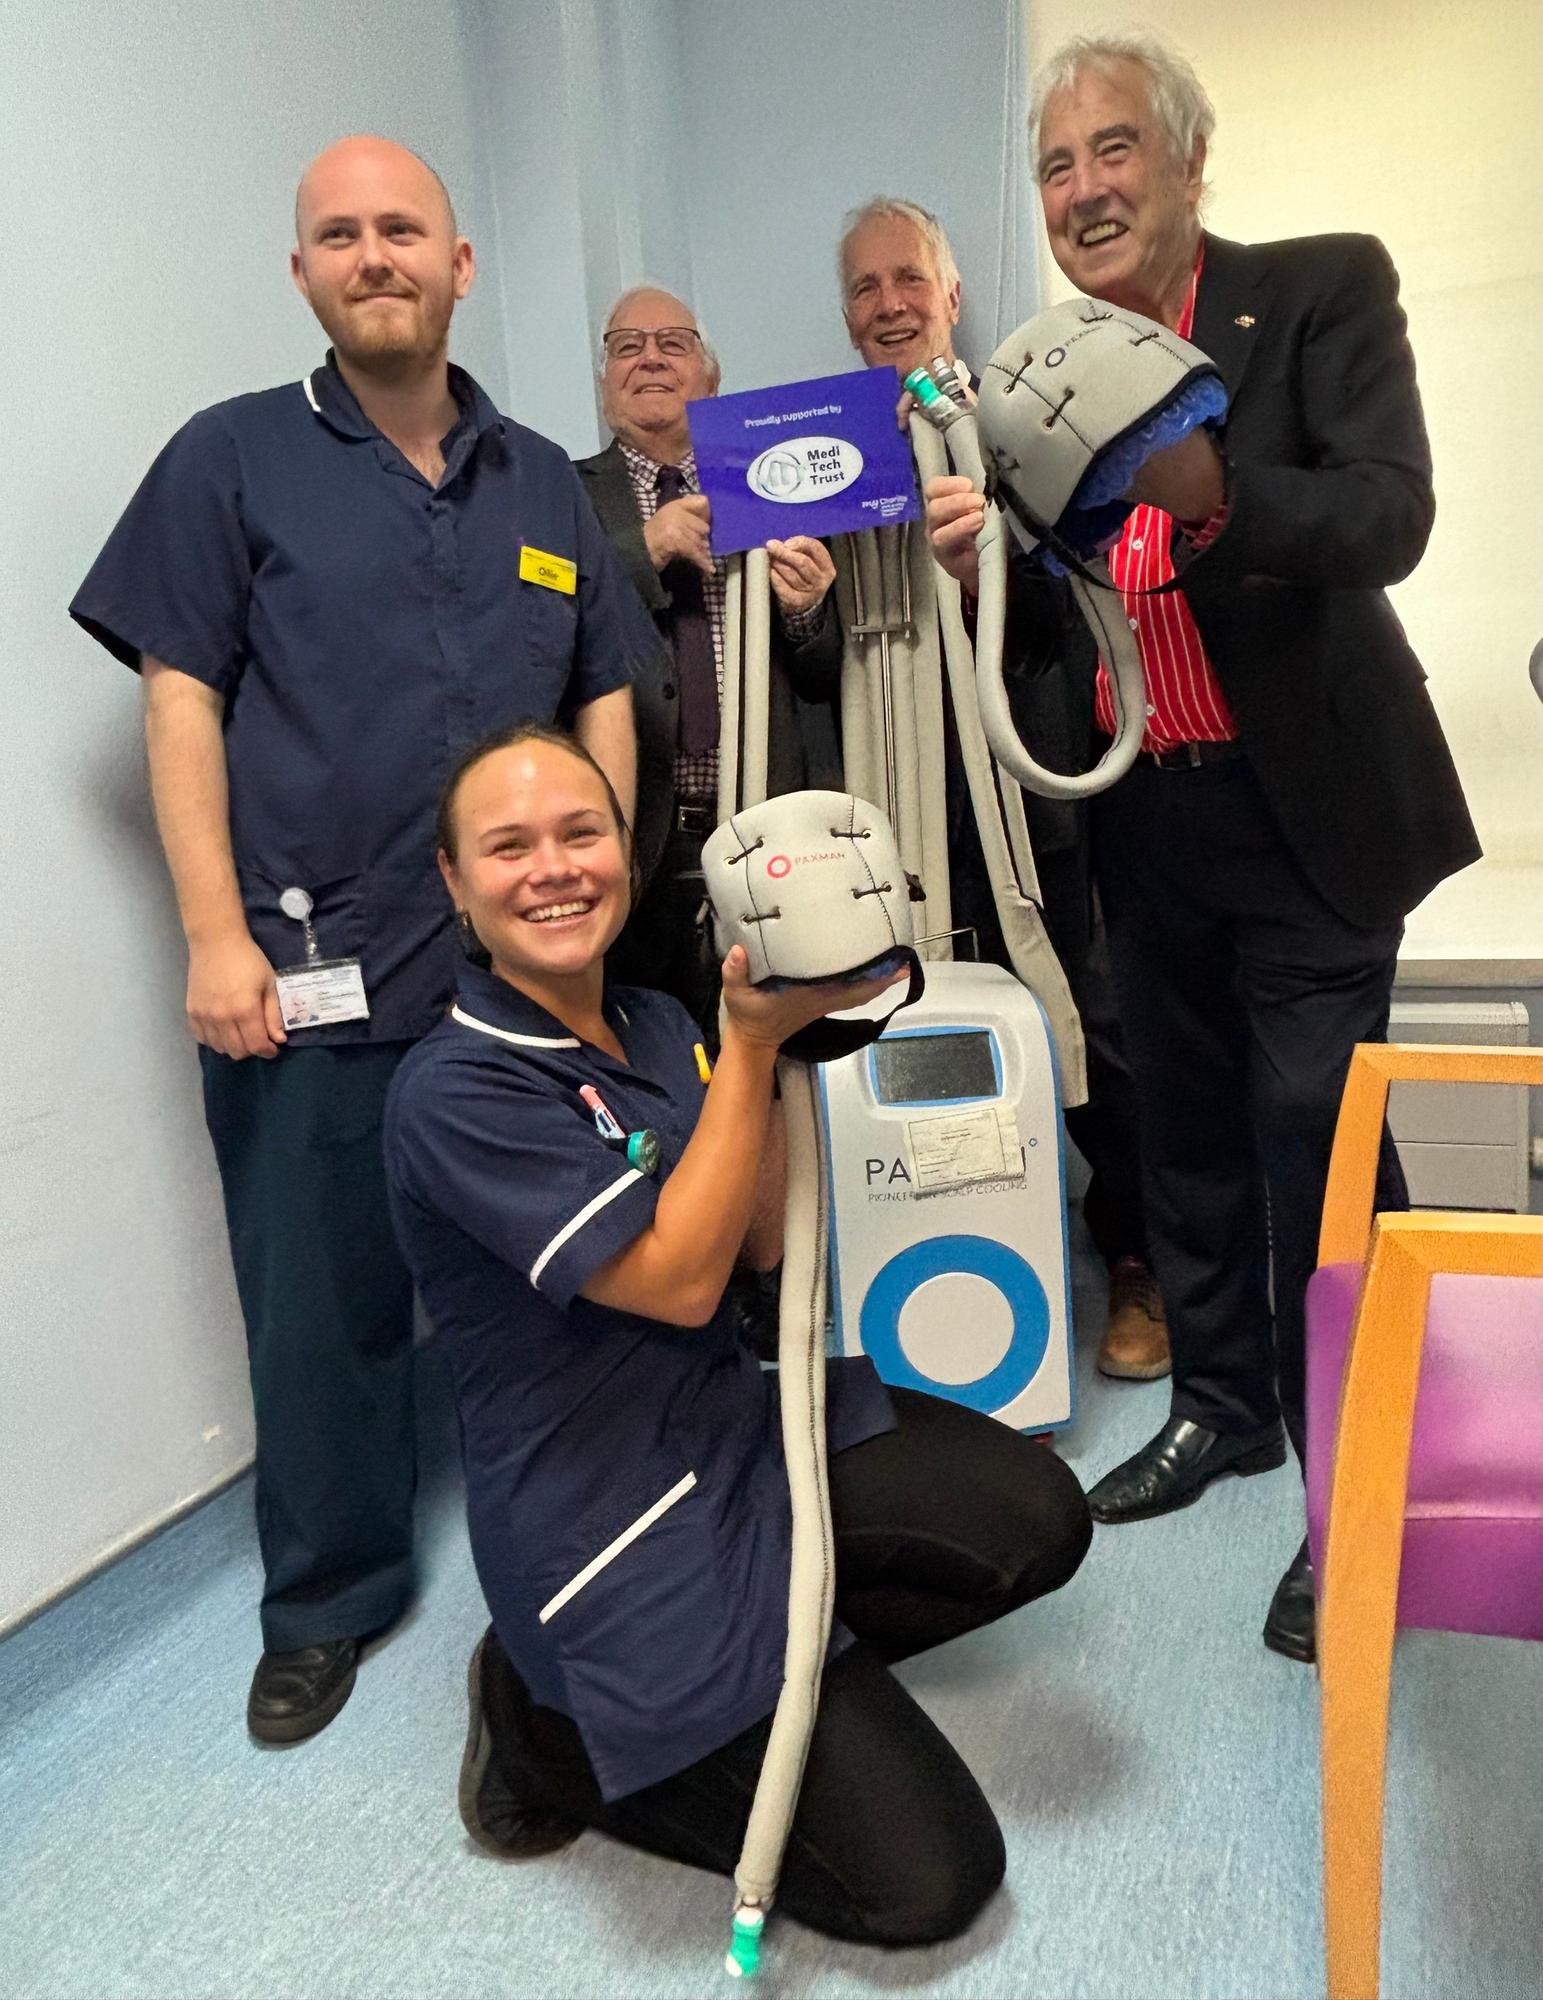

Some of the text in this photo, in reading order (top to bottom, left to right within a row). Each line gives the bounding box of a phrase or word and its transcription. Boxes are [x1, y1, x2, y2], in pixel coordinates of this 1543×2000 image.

[744, 404, 842, 429] Proudly supported by
[807, 445, 840, 461] Medi
[810, 459, 841, 473] Tech
[810, 471, 845, 486] Trust
[795, 852, 845, 865] PAXMAN
